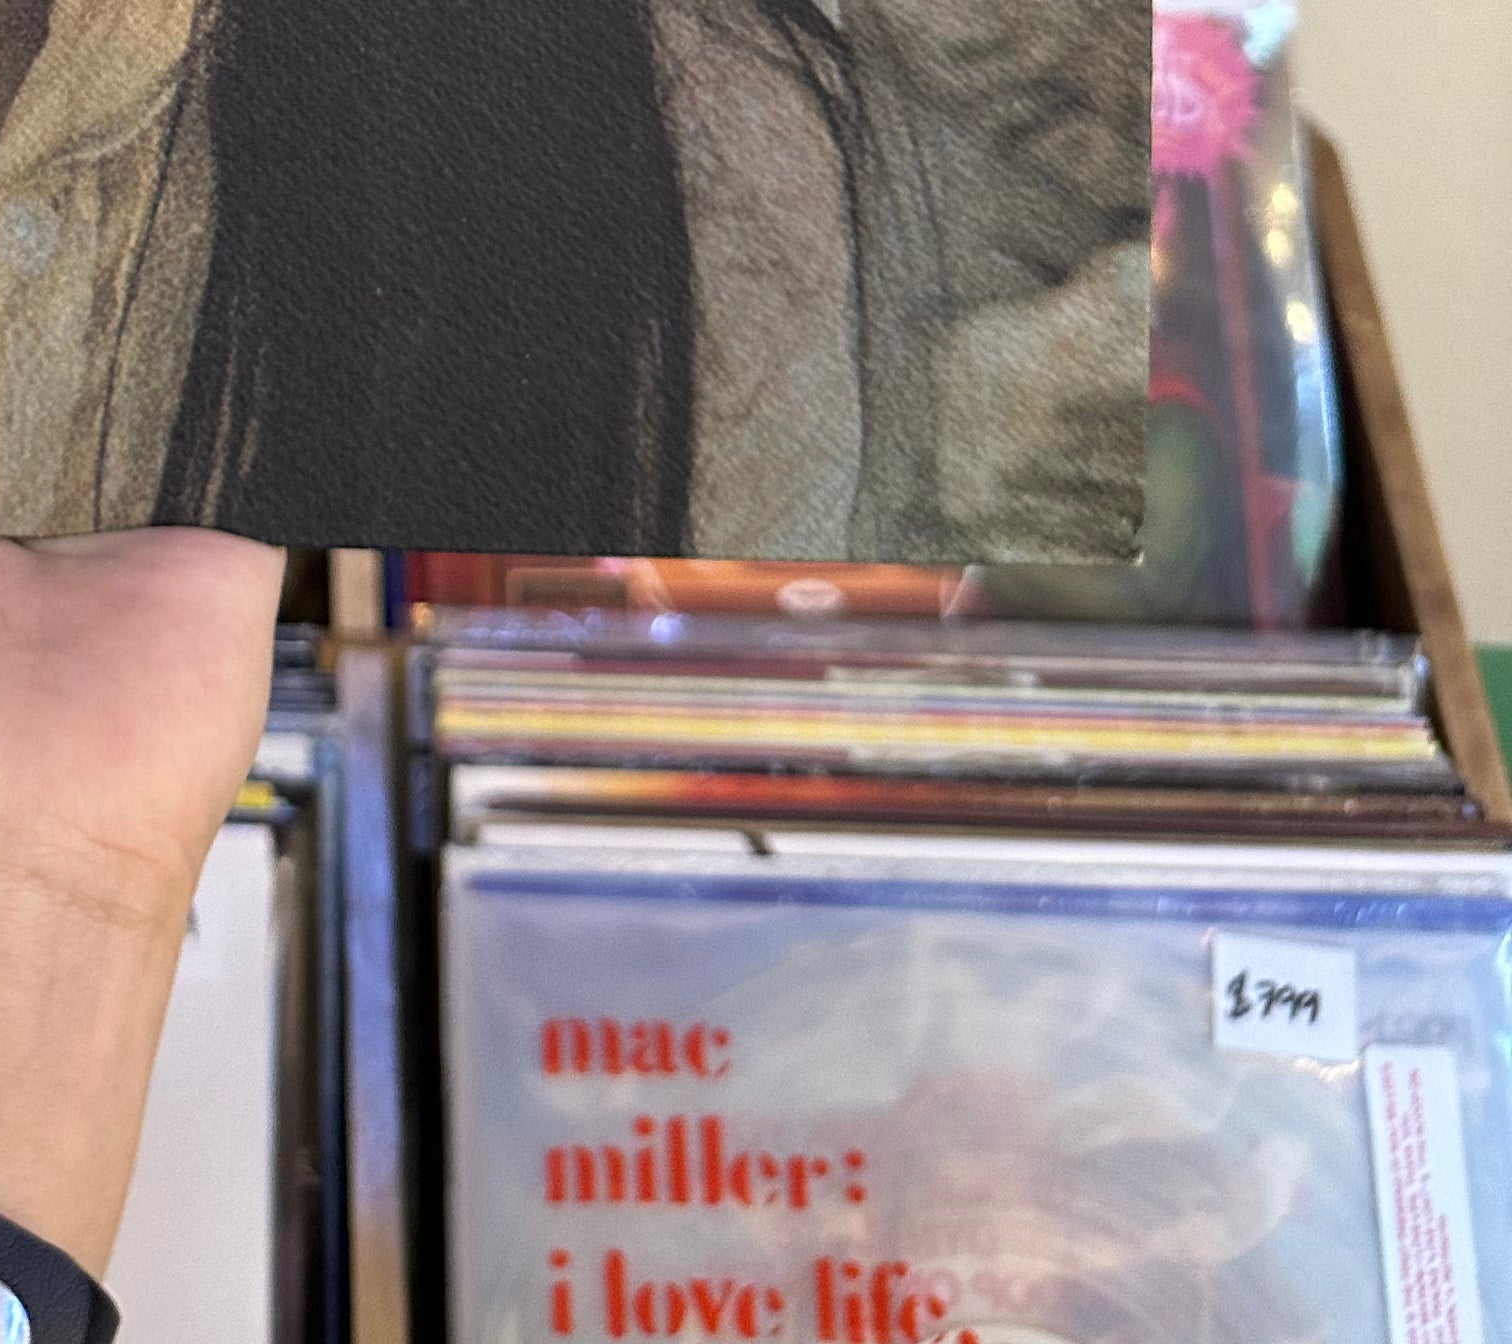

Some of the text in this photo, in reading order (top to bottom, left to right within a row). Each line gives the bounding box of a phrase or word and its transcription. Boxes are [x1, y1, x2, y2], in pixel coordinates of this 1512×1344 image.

[542, 1017, 732, 1080] mac
[545, 1114, 868, 1213] miller:
[548, 1249, 576, 1337] i
[602, 1248, 786, 1341] love
